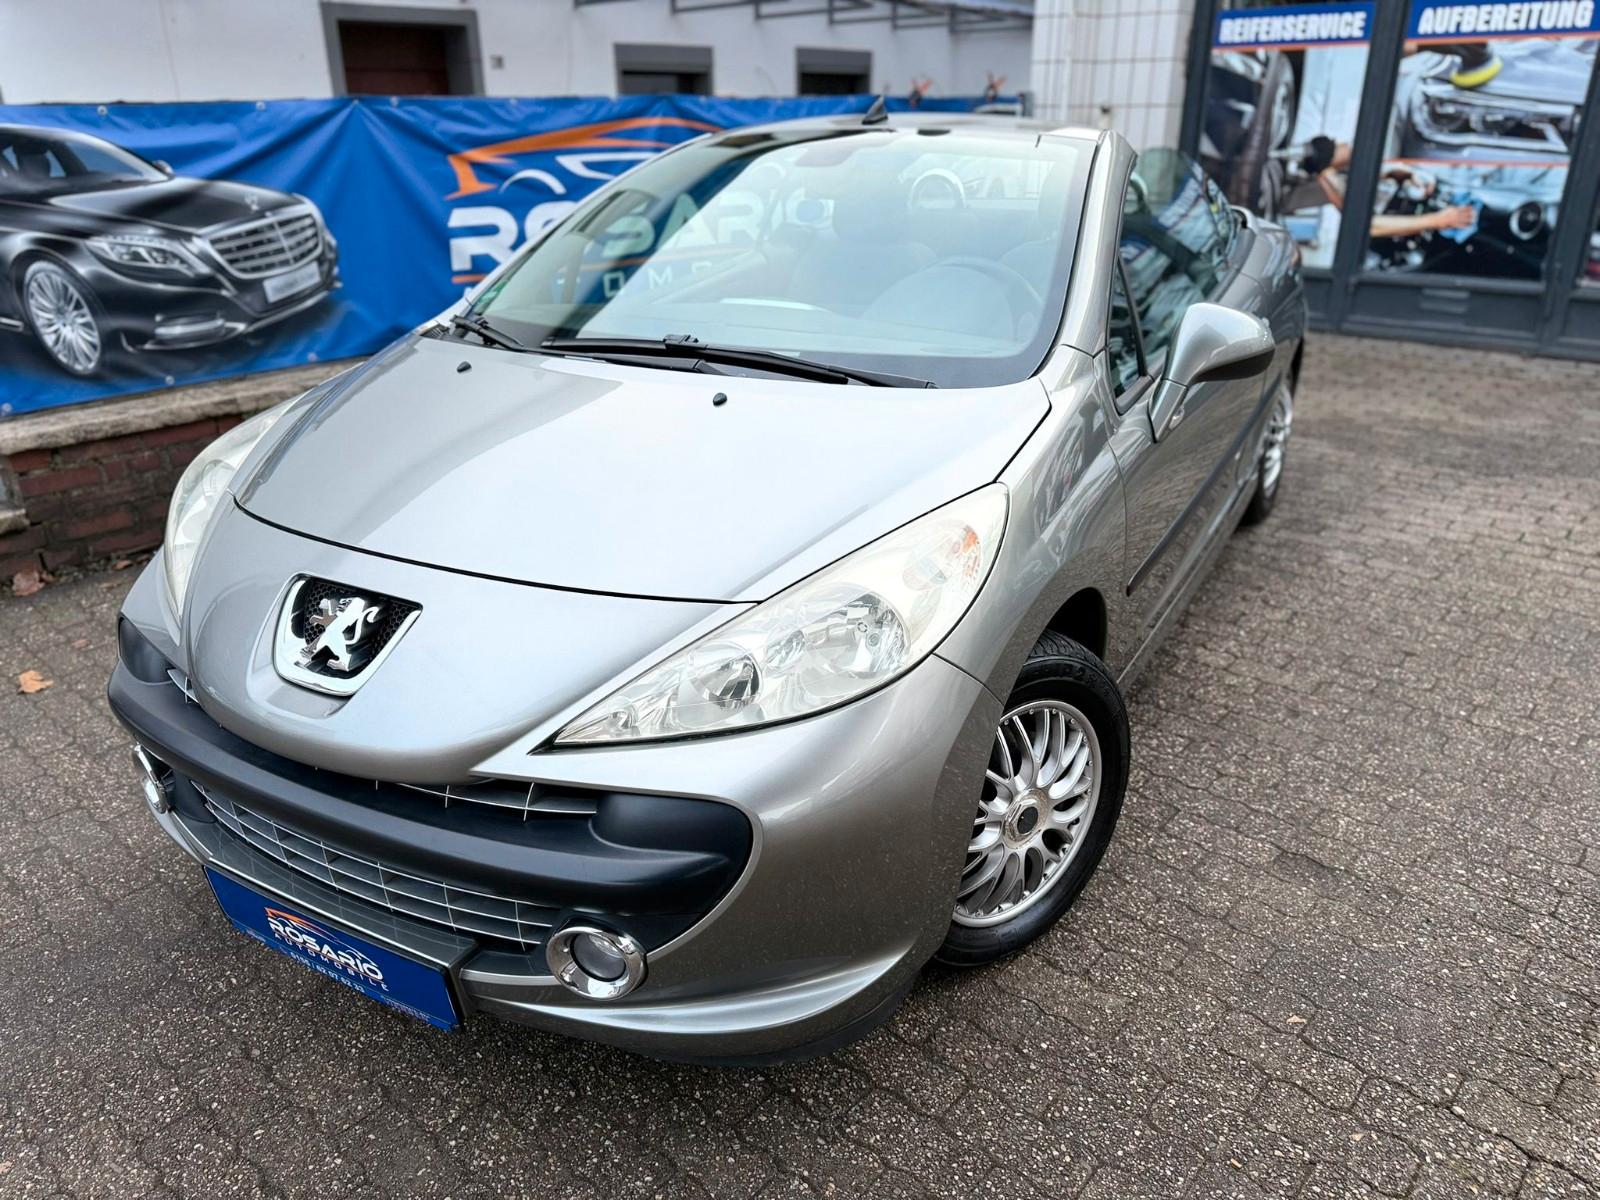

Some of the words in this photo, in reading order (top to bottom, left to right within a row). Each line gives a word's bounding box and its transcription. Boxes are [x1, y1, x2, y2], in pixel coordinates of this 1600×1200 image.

[1219, 11, 1367, 44] REIFENSERVICE
[1417, 0, 1595, 35] AUFBEREITUNG
[268, 917, 384, 980] ROSARIO
[274, 932, 390, 992] AUTOMOBILE
